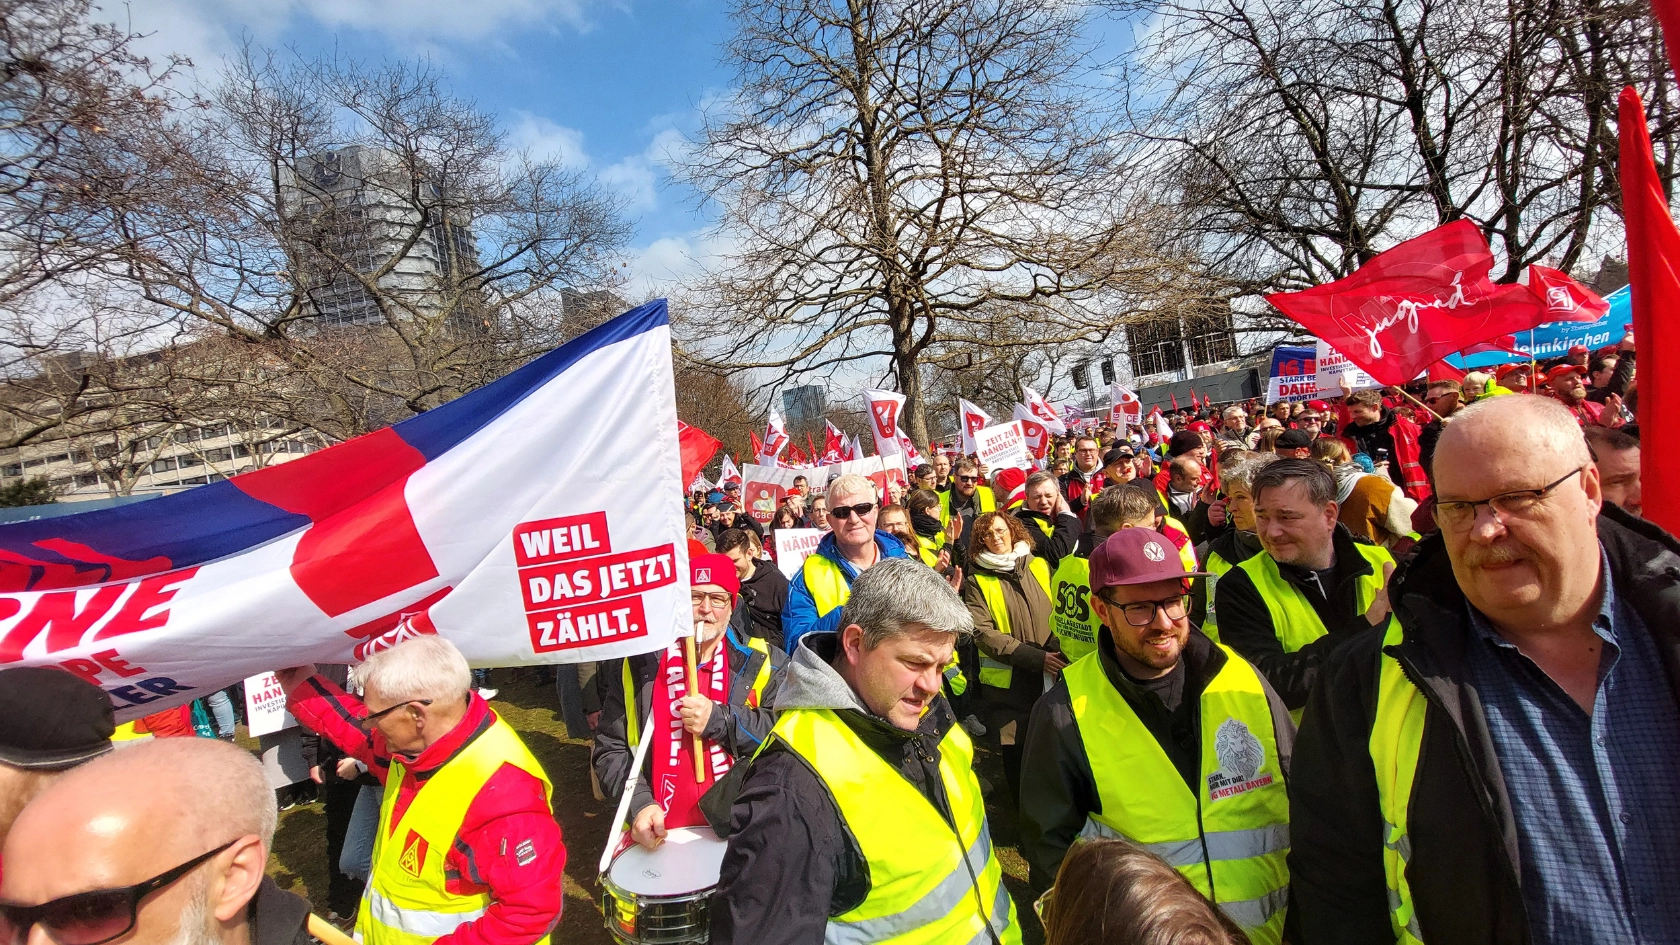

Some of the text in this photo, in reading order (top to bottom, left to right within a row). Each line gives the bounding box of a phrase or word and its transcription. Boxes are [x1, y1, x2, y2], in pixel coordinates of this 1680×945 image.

[1278, 360, 1299, 376] IG
[1279, 375, 1305, 383] STARK
[986, 430, 1014, 447] ZEIT ZU
[520, 524, 600, 559] WEIL
[529, 554, 671, 604] DAS JETZT
[1055, 581, 1090, 622] SOS
[537, 607, 639, 647] ZÄHLT.
[252, 687, 282, 704] HAN
[255, 697, 286, 712] INVESTIE
[267, 703, 285, 714] KAPU
[1208, 773, 1225, 784] STARK.
[1220, 778, 1231, 786] MIT
[1211, 776, 1272, 800] IG METALL BAYERN
